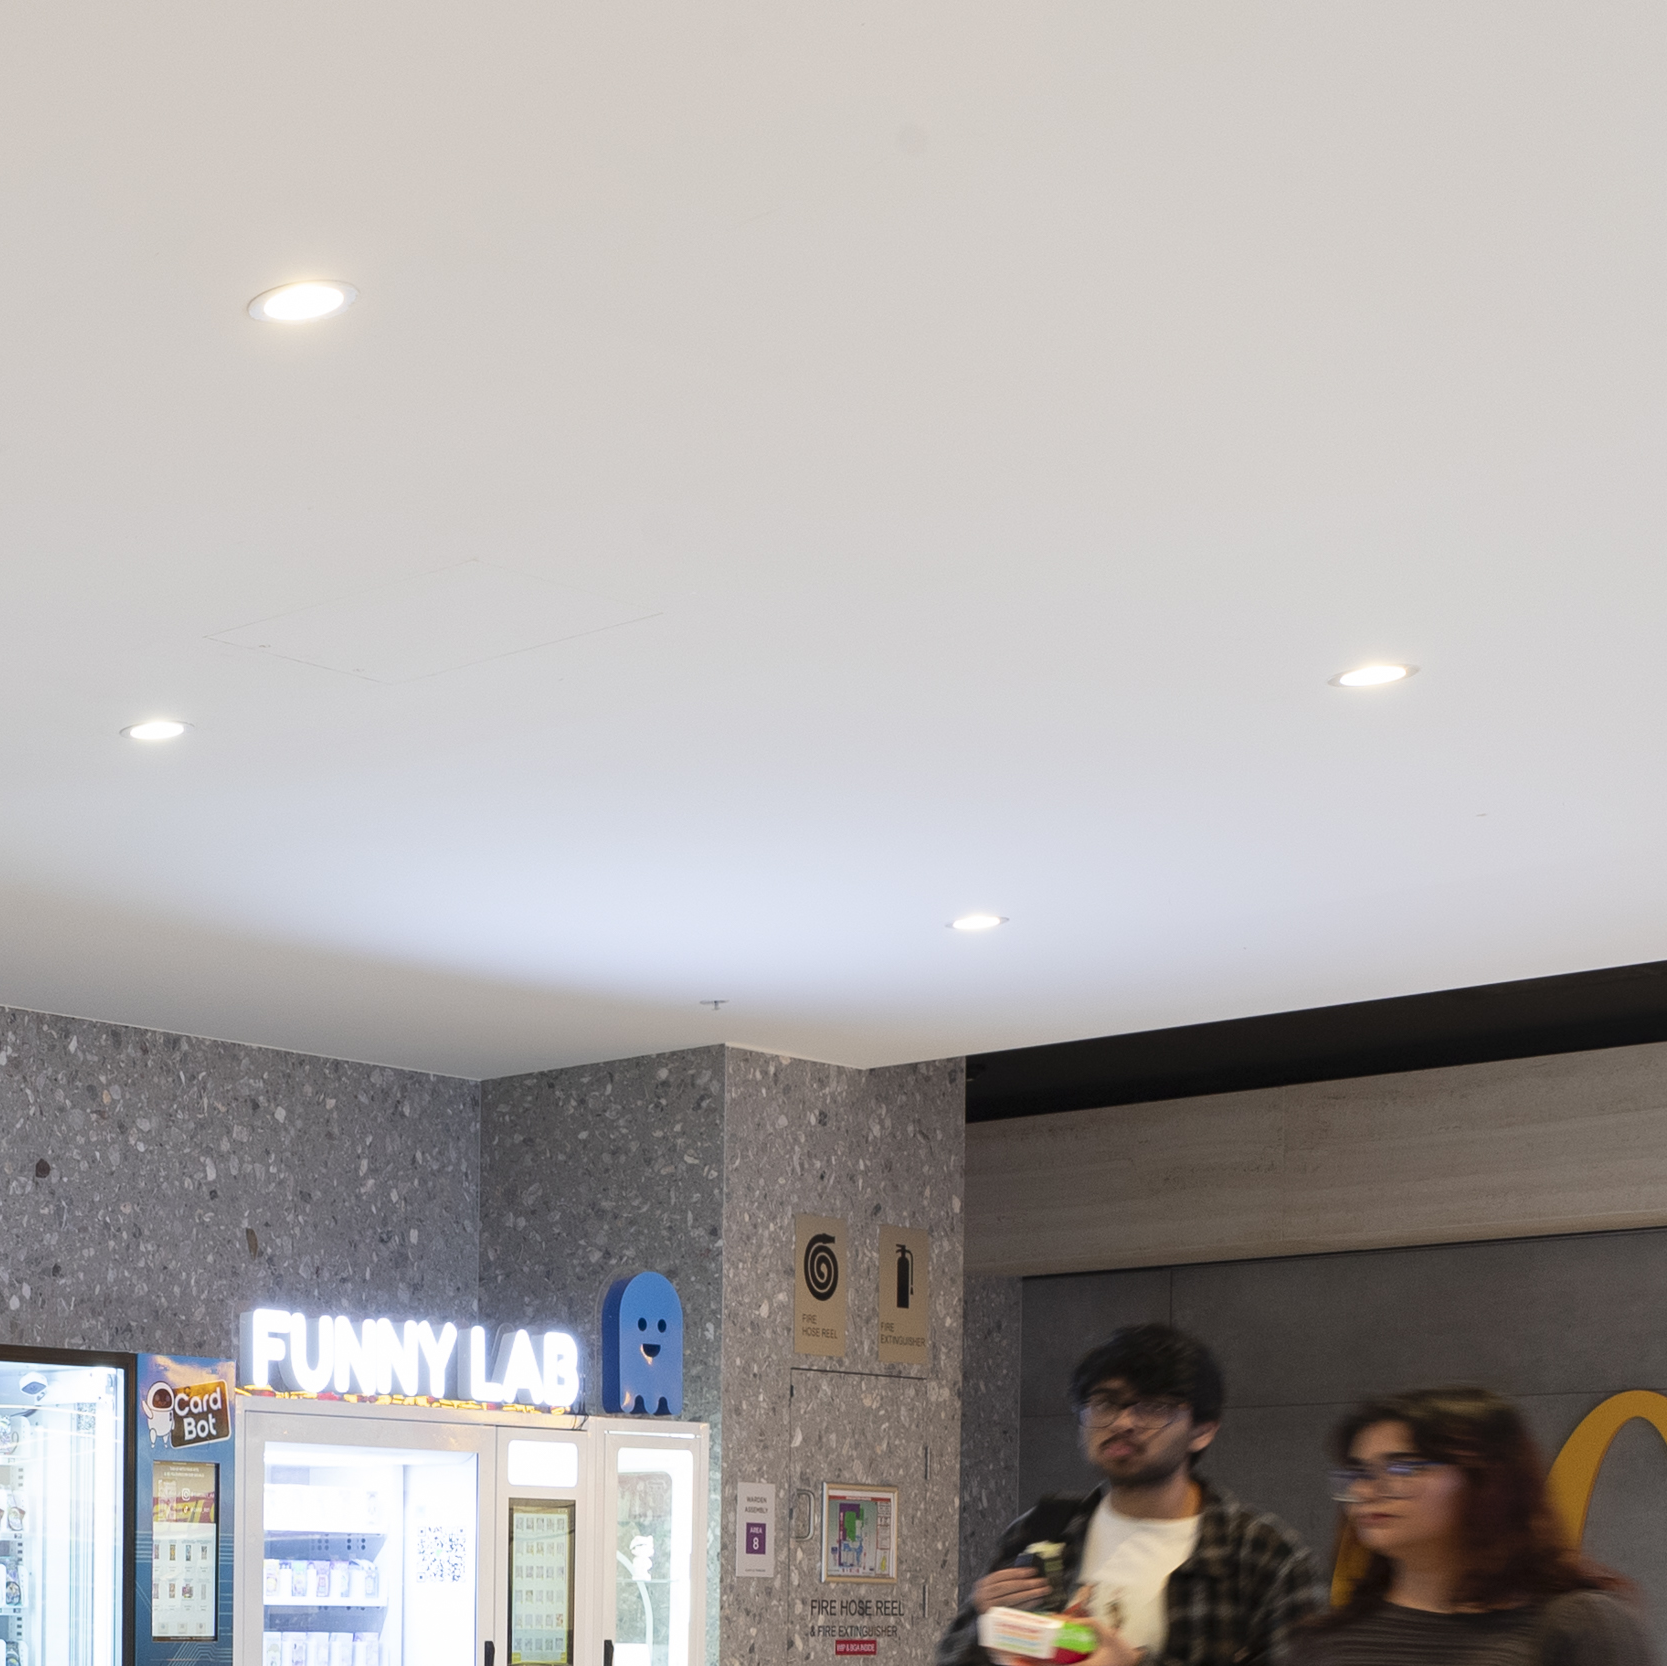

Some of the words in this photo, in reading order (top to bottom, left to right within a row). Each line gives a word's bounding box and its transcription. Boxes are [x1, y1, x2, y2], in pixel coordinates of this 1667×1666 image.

[802, 1313, 817, 1325] FIRE
[802, 1327, 820, 1337] HOSE
[822, 1328, 838, 1339] REEL
[881, 1322, 894, 1332] FIRE
[881, 1334, 926, 1347] EXTINGUISHER
[252, 1307, 457, 1399] FUNNY
[470, 1325, 581, 1408] LAB
[175, 1387, 222, 1416] Card
[183, 1413, 216, 1440] Bot
[752, 1537, 759, 1550] 8
[810, 1599, 837, 1616] FIRE
[840, 1599, 873, 1616] HOSE
[875, 1599, 904, 1616] REEL
[809, 1625, 816, 1637] &
[817, 1625, 836, 1637] FIRE
[838, 1625, 898, 1638] EXTINGUISHER
